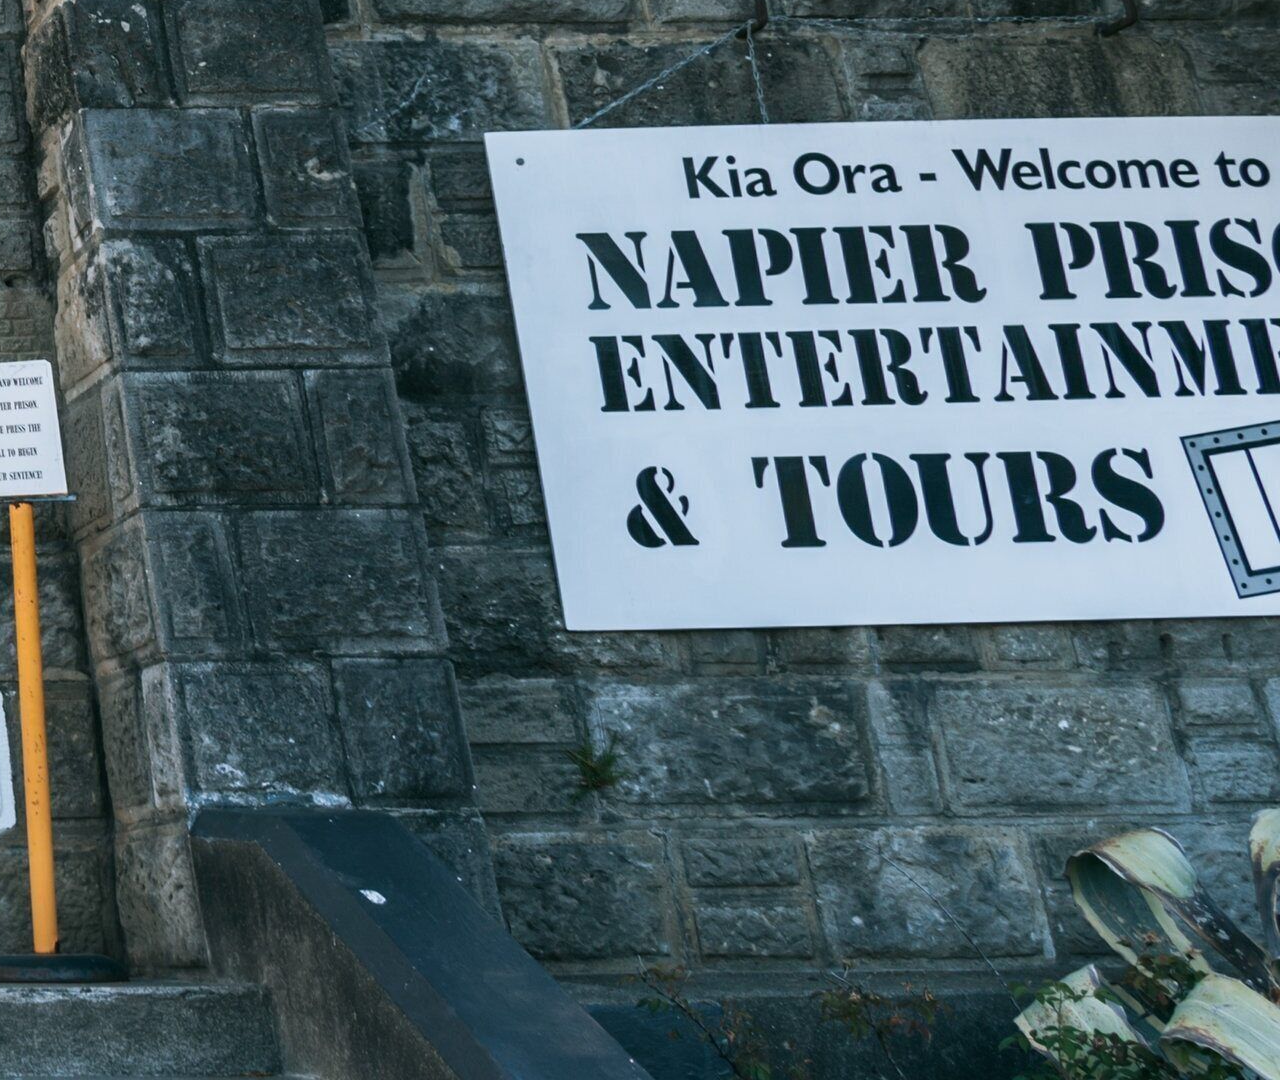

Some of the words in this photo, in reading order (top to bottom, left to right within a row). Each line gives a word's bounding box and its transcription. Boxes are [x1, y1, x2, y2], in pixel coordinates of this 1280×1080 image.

[683, 155, 777, 199] Kia
[793, 151, 902, 195] Ora
[952, 147, 1200, 191] Welcome
[1214, 150, 1271, 188] to
[575, 223, 987, 310] NAPIER
[1025, 217, 1280, 300] PRIS
[13, 376, 43, 387] WELCOME
[14, 400, 38, 410] PRISON
[6, 424, 26, 434] PRESS
[28, 423, 41, 433] THE
[7, 448, 16, 457] TO
[18, 447, 38, 457] BEGIN
[626, 465, 700, 548] &
[752, 447, 1166, 548] TOURS
